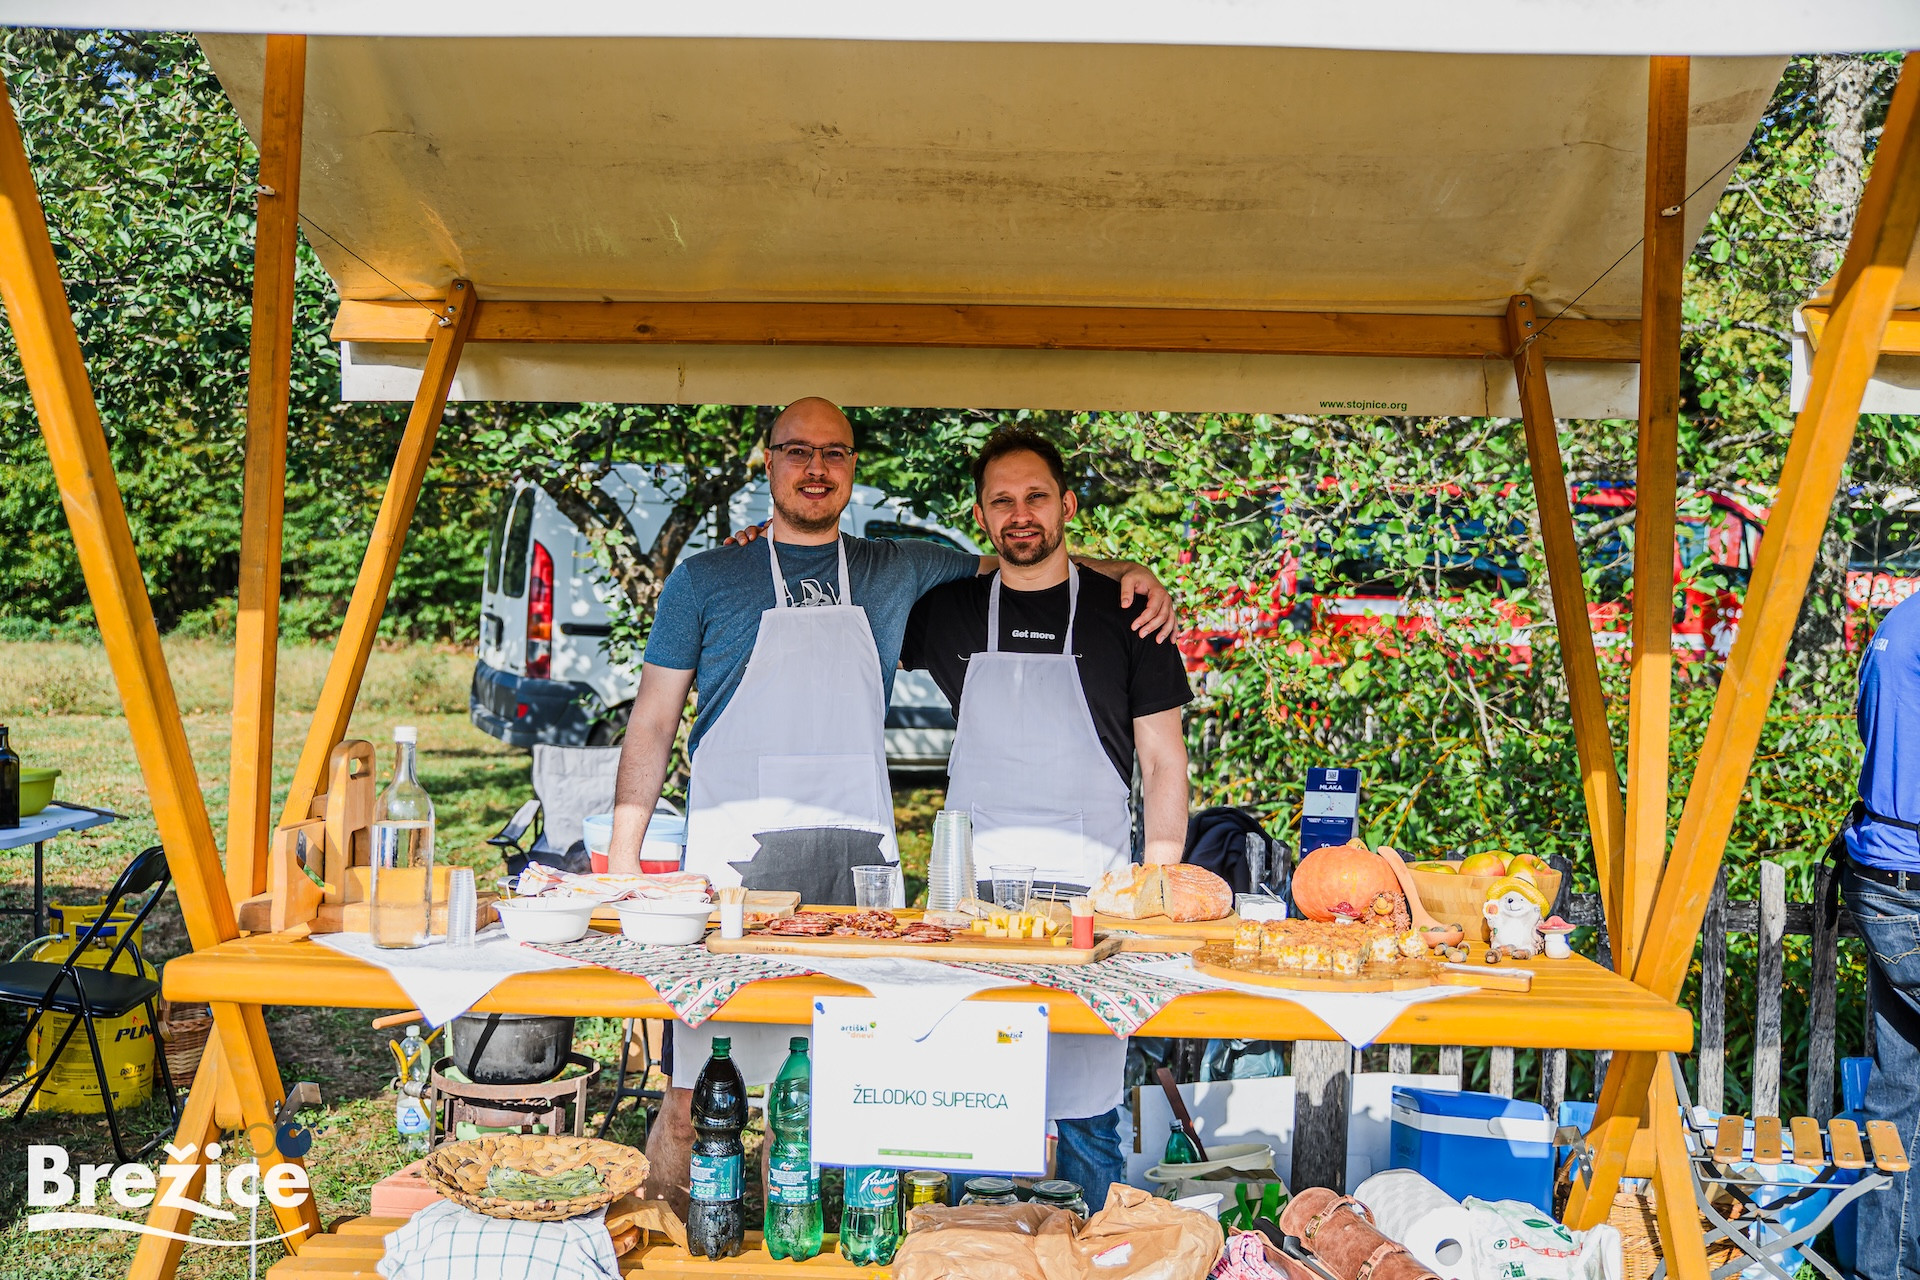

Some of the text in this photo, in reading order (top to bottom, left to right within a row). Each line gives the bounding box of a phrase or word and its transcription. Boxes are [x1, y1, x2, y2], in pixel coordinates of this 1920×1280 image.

[1320, 400, 1407, 411] www.stojnice.org
[1012, 629, 1055, 640] Get more
[853, 1084, 1009, 1109] ŽELODKO SUPERCA
